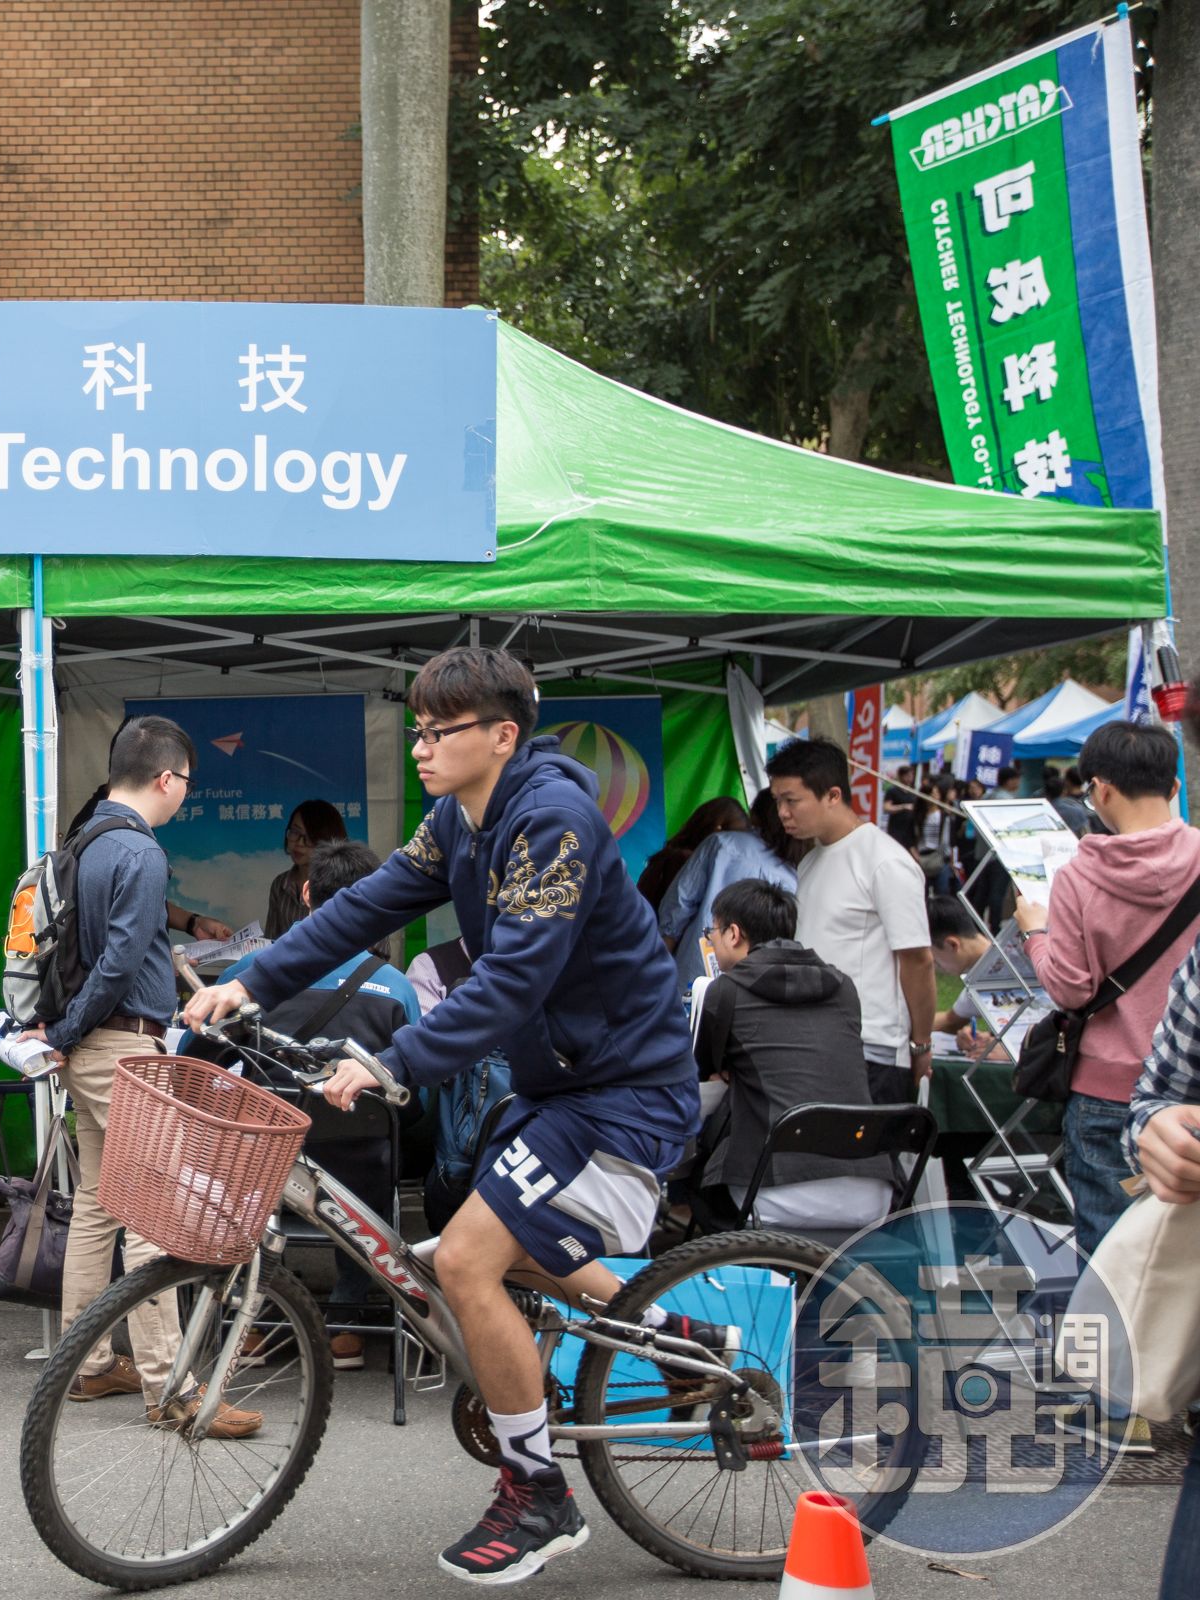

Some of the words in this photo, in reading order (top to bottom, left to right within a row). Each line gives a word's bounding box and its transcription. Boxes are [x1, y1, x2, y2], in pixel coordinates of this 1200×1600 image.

[205, 788, 243, 799] Future
[492, 1135, 558, 1208] 24
[317, 1199, 425, 1293] GIANT
